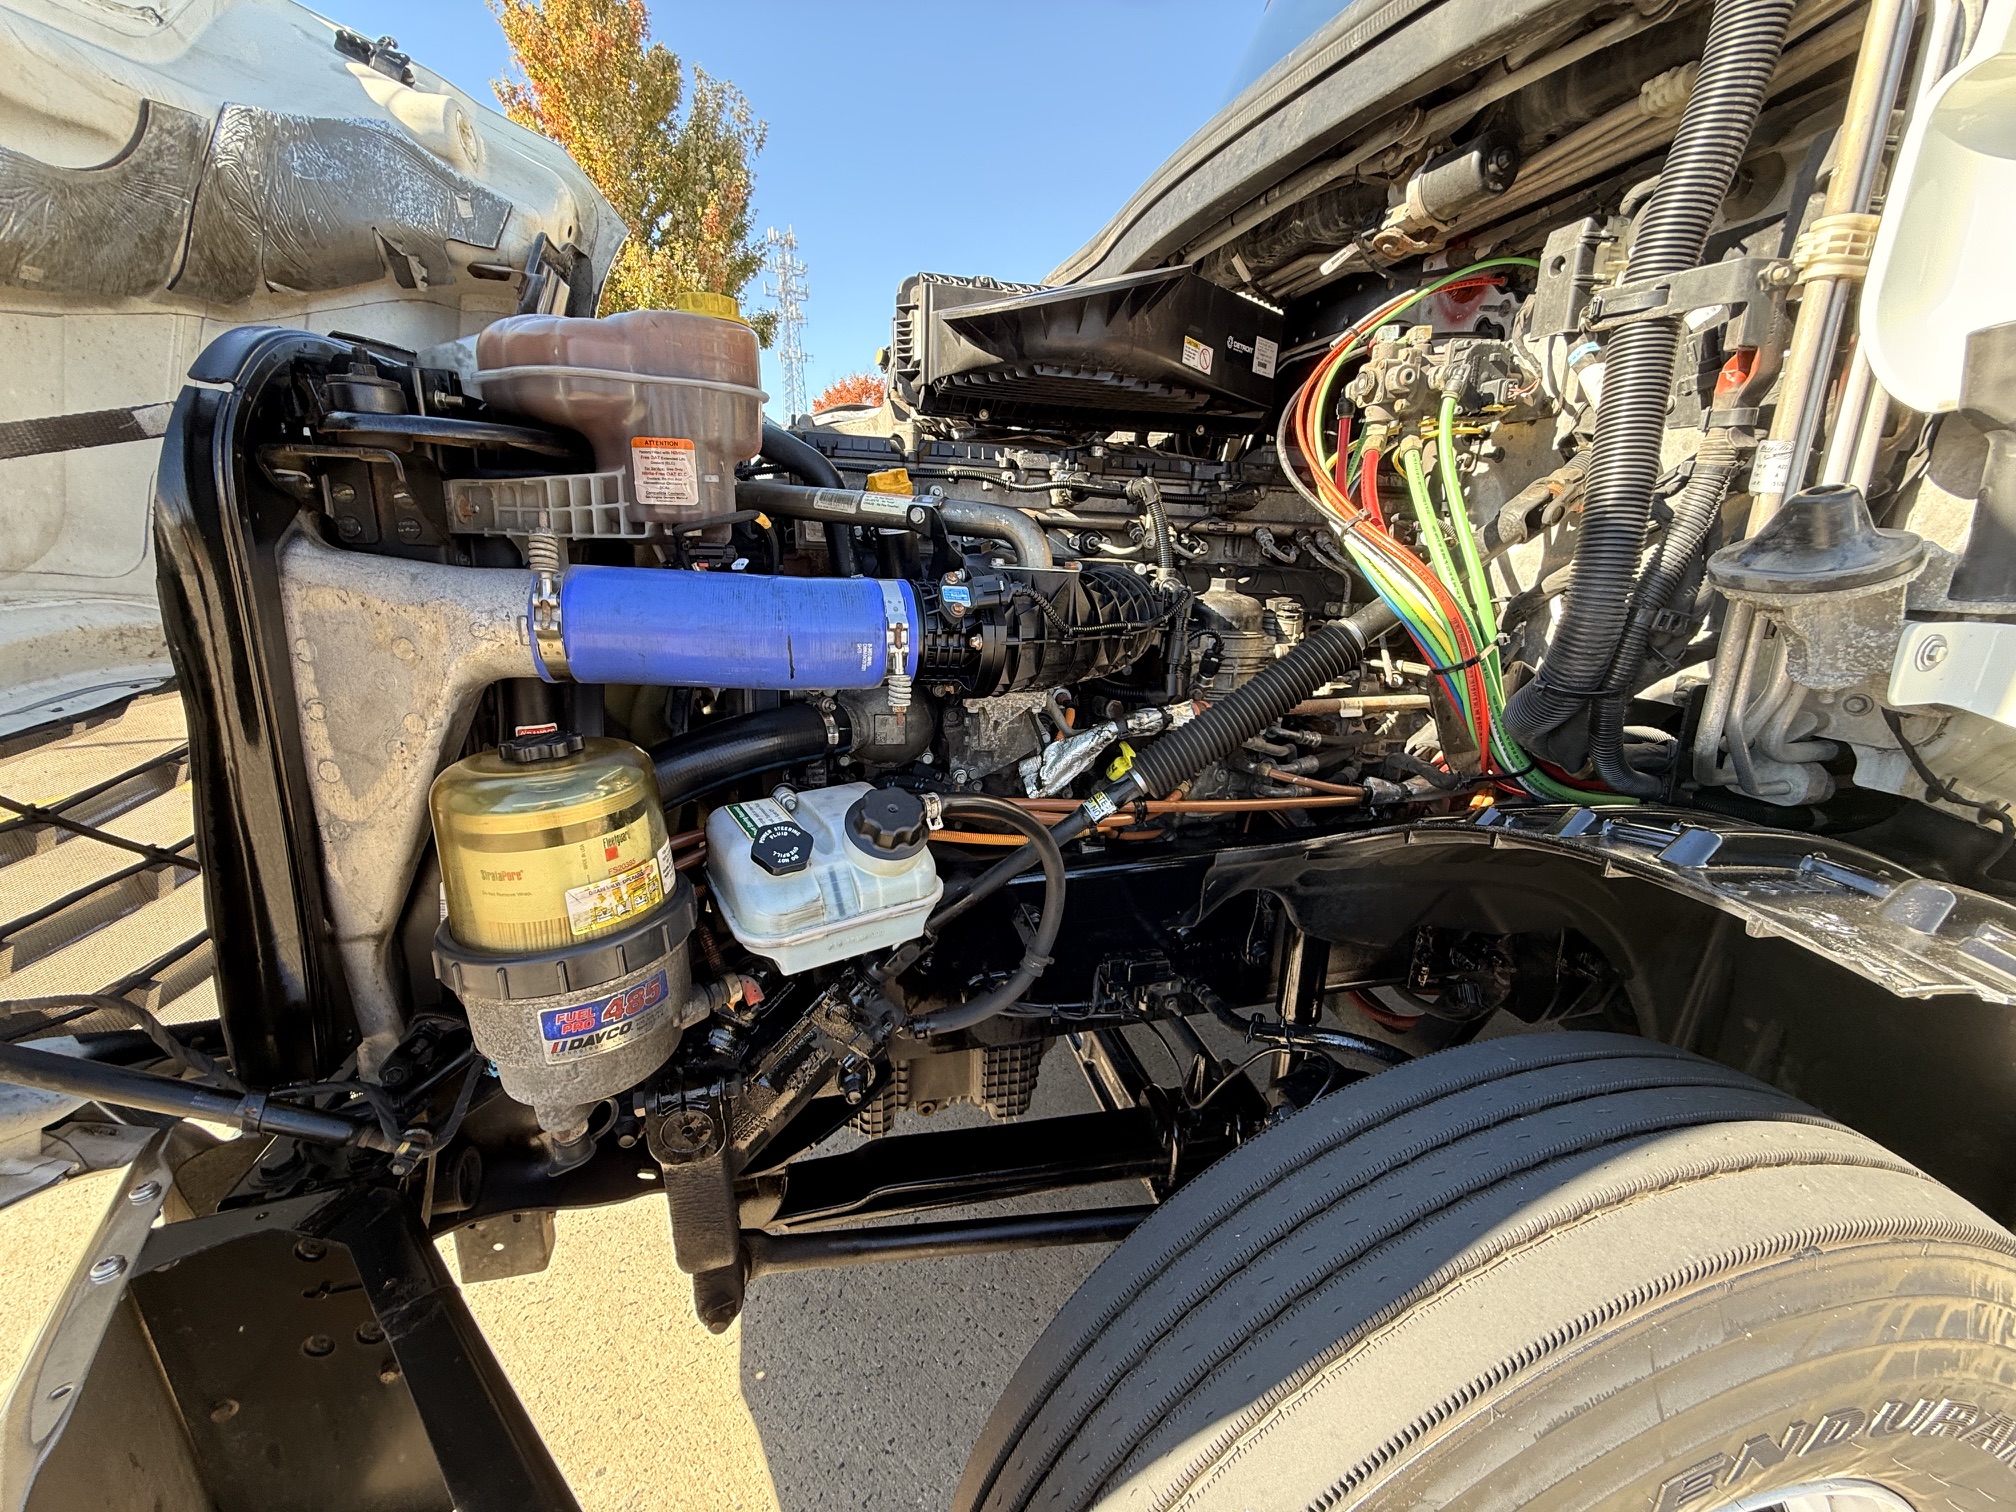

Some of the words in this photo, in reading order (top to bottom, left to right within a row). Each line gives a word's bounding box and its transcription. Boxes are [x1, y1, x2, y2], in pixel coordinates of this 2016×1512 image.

[1233, 341, 1254, 354] DETROIT
[644, 439, 679, 447] ATTENTION
[758, 829, 773, 844] POWER
[773, 825, 802, 837] STEERING
[769, 831, 789, 840] FLUID
[772, 846, 799, 858] OVERFILL
[790, 854, 800, 862] DO
[608, 857, 637, 875] FS20385
[601, 977, 662, 1024] 485
[555, 1007, 596, 1025] FUEL
[561, 1018, 596, 1035] PRO
[569, 1021, 633, 1051] DAVCO
